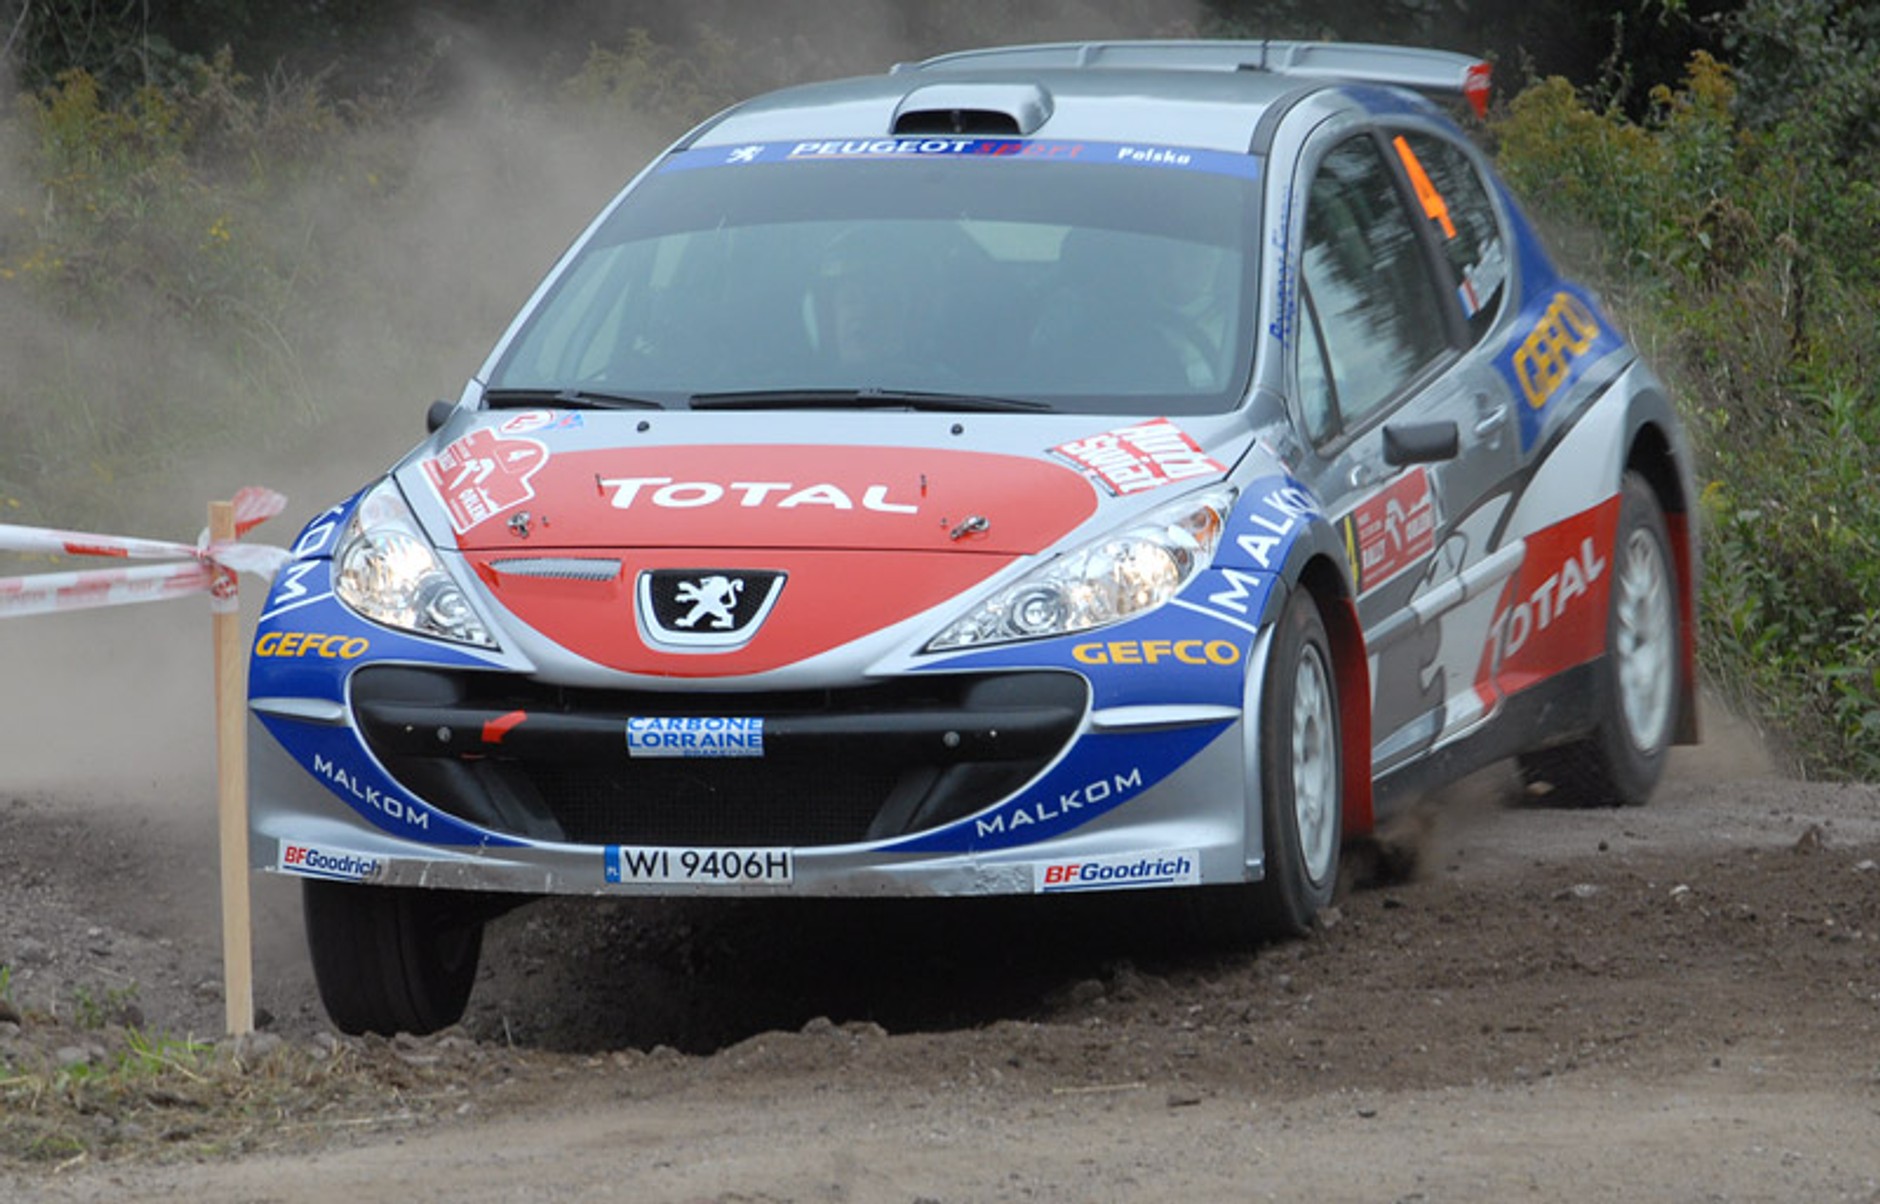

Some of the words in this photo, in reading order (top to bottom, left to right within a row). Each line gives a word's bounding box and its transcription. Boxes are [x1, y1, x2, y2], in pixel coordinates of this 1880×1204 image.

[791, 140, 975, 156] PEUGEOT
[976, 142, 1084, 158] sport
[1117, 146, 1191, 165] Polska
[1393, 135, 1457, 239] 4
[1512, 292, 1598, 408] GEFCO
[601, 477, 919, 514] TOTAL
[1208, 487, 1320, 614] MALKO
[1490, 536, 1606, 675] TOTAL
[255, 631, 371, 660] GEFCO
[1072, 640, 1241, 665] GEFCO
[628, 716, 763, 731] CARBONE
[628, 732, 763, 748] LORRAINE
[313, 753, 430, 830] MALKOM
[975, 767, 1143, 838] MALKOM
[284, 846, 382, 877] BFGoodrich
[624, 850, 669, 878] WI
[681, 850, 789, 879] 9406H
[1043, 856, 1191, 884] BFGoodrich
